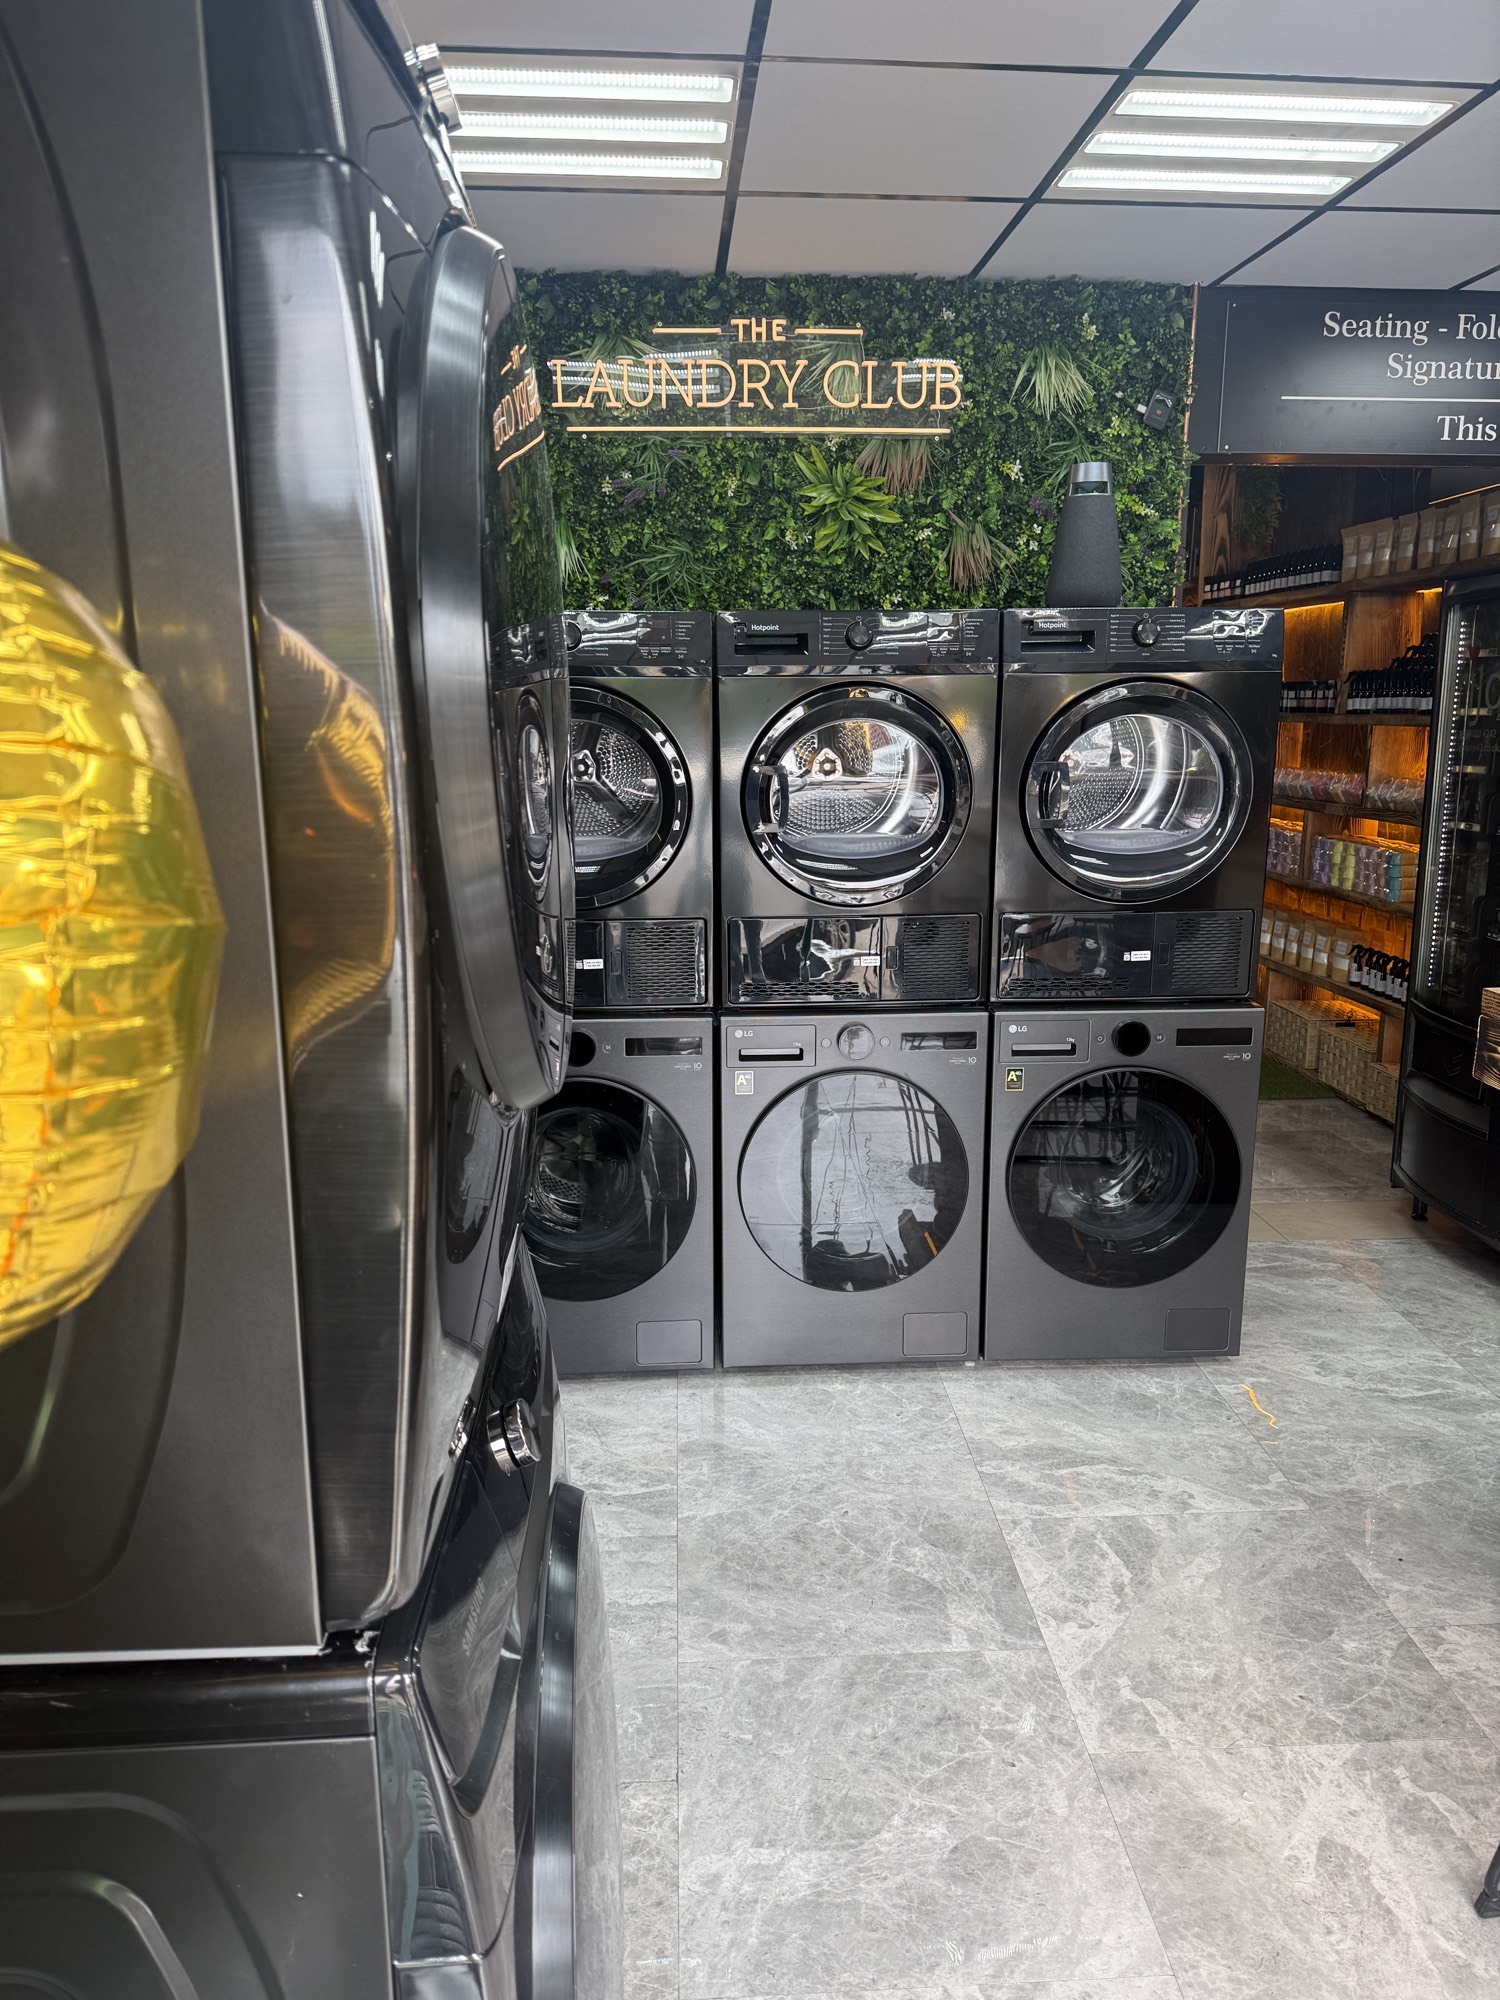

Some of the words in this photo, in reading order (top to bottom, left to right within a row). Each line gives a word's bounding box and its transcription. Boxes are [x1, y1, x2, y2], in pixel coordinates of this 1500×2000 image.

[730, 318, 787, 343] THE
[1323, 311, 1430, 346] Seating
[1456, 314, 1500, 340] Fol
[551, 359, 809, 409] LAUNDRY
[823, 359, 962, 410] CLUB
[1437, 415, 1497, 441] This
[751, 624, 780, 632] Hotpoint
[1038, 621, 1067, 630] Hotpoint
[1017, 1025, 1028, 1033] LG
[462, 1576, 485, 1656] SAMSUNG
